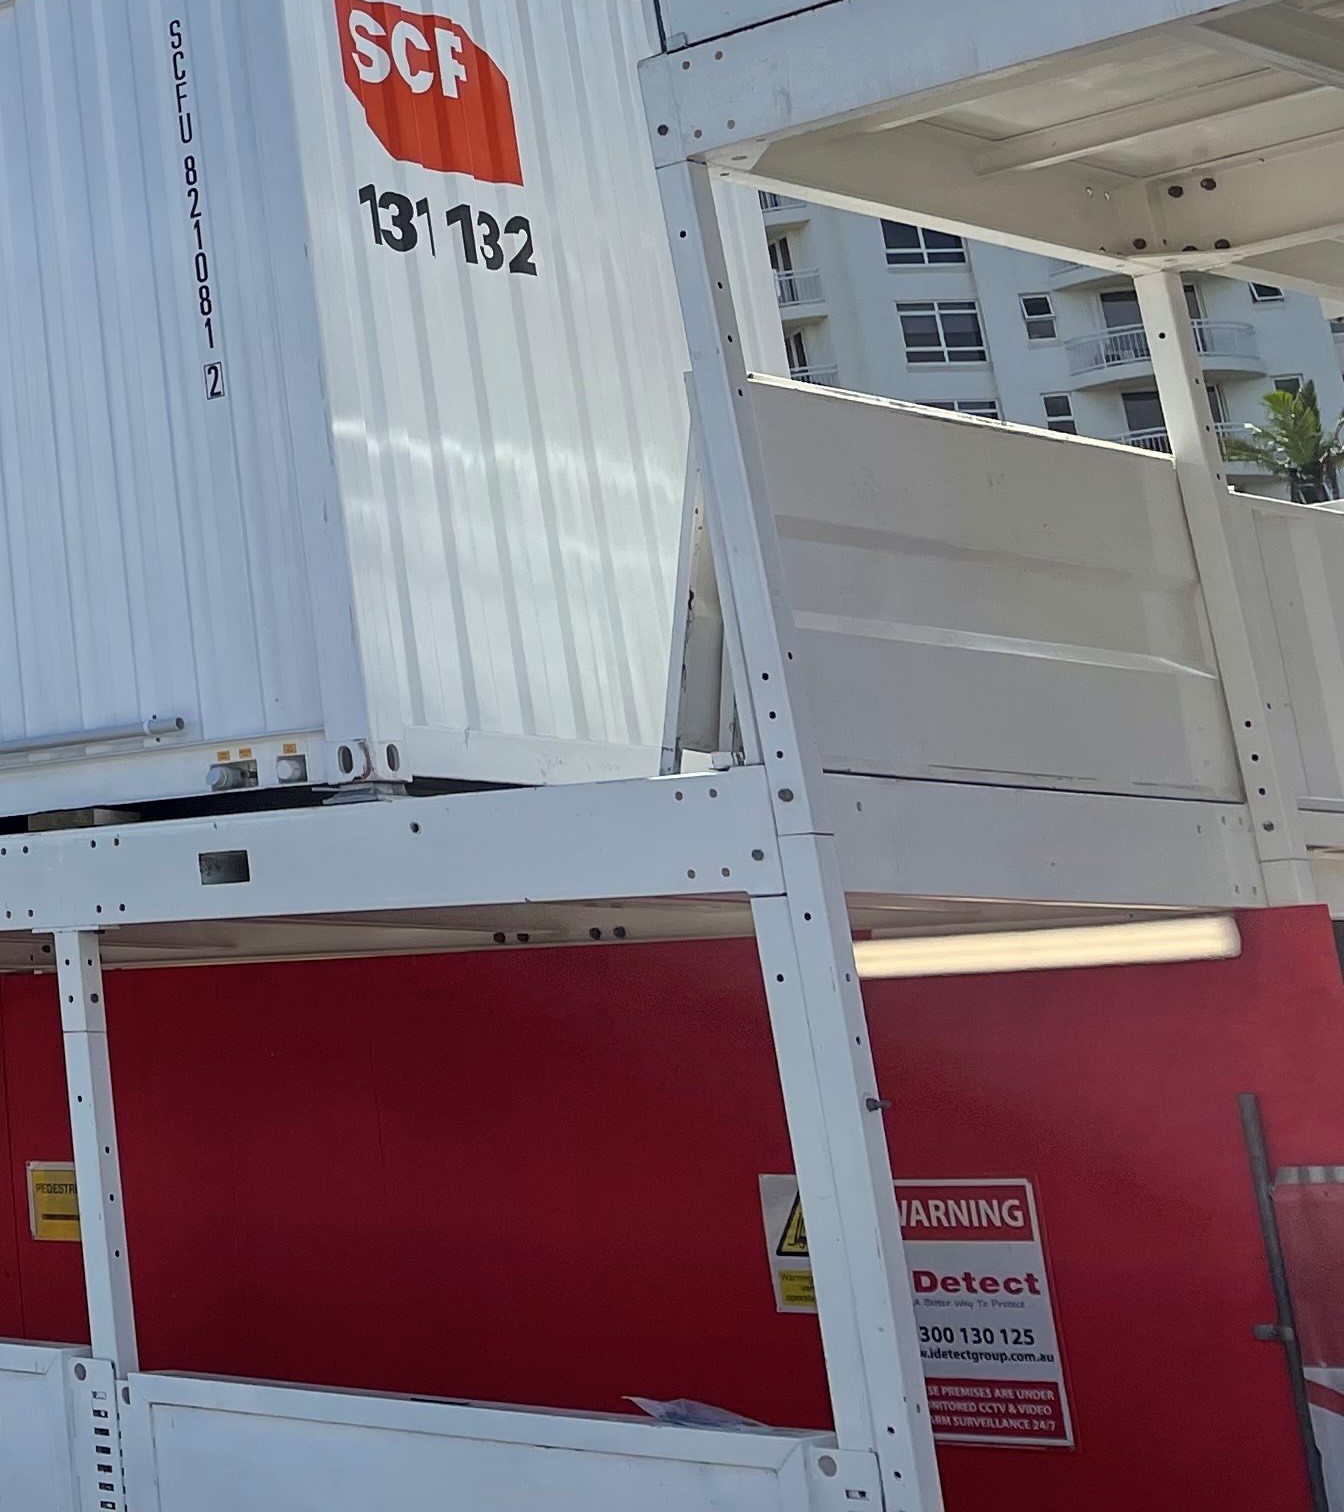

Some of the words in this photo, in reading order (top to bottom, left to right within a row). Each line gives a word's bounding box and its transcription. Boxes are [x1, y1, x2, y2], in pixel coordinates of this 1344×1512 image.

[349, 10, 467, 99] SCF
[169, 20, 193, 144] SCFU
[183, 156, 214, 349] 821081
[359, 185, 437, 259] 131
[446, 204, 538, 277] 132
[960, 1327, 995, 1345] 130
[1000, 1328, 1035, 1346] 125
[941, 1386, 992, 1399] PREMISES
[994, 1388, 1016, 1399] ARE
[1016, 1389, 1055, 1401] UNDER
[978, 1402, 1006, 1415] CCTV
[1016, 1404, 1053, 1416] VIDEO
[953, 1417, 1031, 1430] SURVEILLANCE
[1032, 1419, 1056, 1432] 24/7
